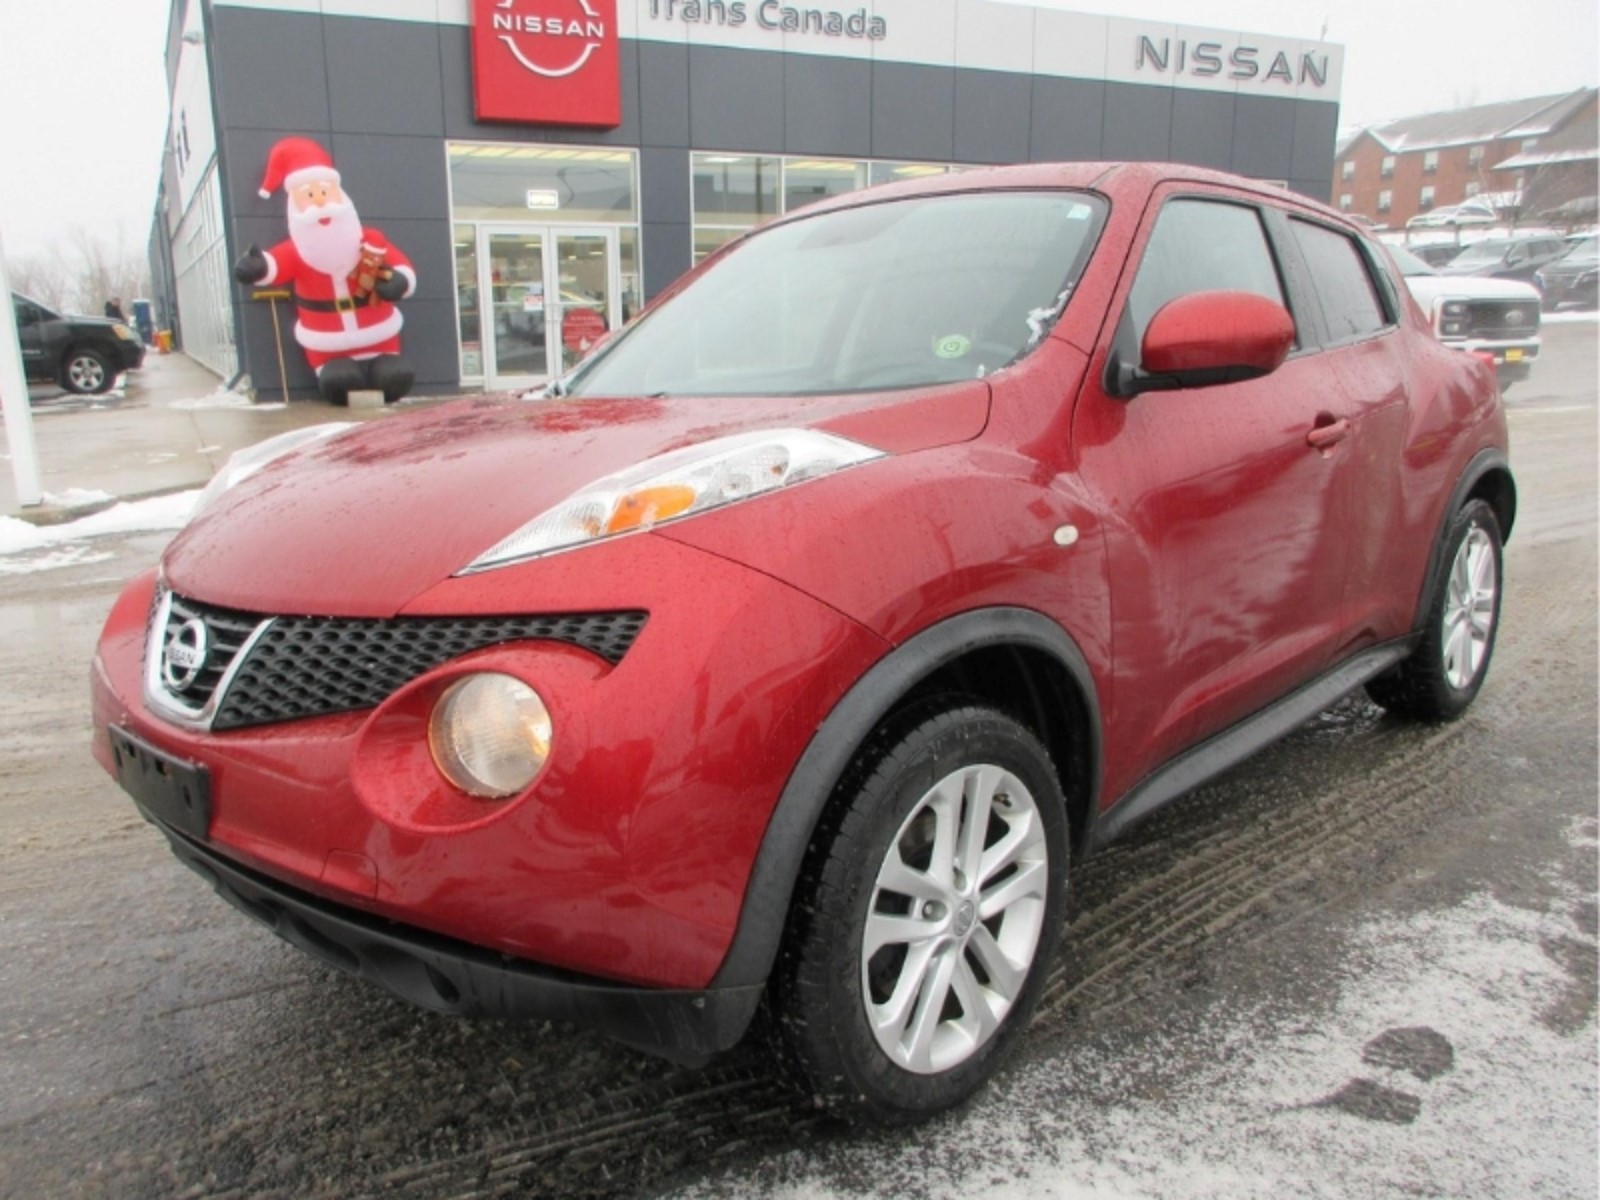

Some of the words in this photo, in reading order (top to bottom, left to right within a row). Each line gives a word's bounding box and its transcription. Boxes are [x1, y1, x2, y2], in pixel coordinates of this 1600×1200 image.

[493, 13, 604, 38] NISSAN
[756, 0, 887, 40] Canada
[1136, 35, 1329, 87] NISSAN
